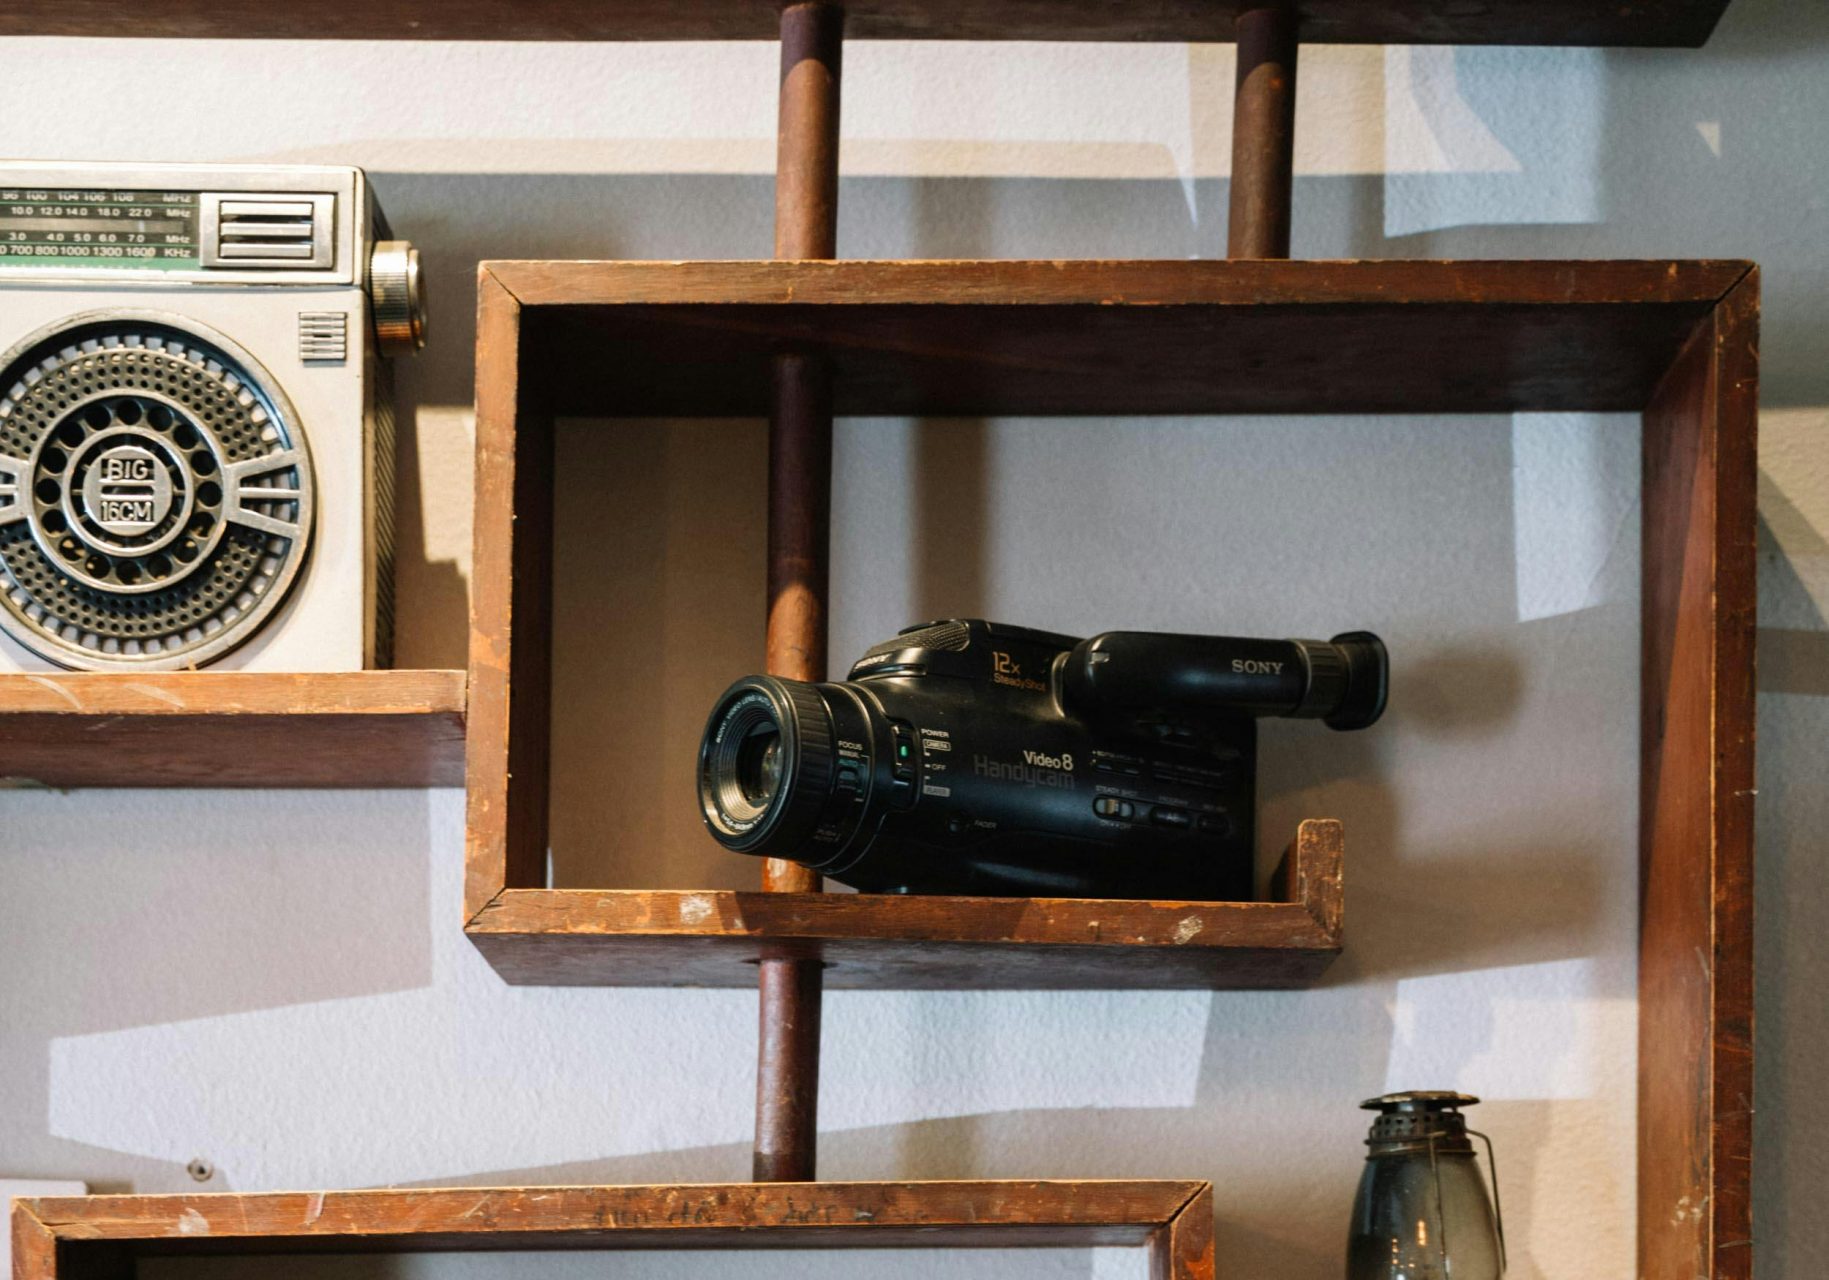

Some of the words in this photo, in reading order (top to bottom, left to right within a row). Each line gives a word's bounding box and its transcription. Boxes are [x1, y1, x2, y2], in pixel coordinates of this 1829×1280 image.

[11, 206, 34, 216] 10.0
[40, 206, 63, 216] 12.0
[66, 207, 88, 217] 14.0
[128, 208, 152, 218] 22.0
[166, 208, 191, 218] MHz
[9, 232, 27, 241] 3.0
[46, 233, 65, 242] 4.0
[73, 233, 92, 242] 5.0
[98, 234, 117, 243] 6.0
[128, 234, 145, 243] 7.0
[165, 235, 191, 244] MHz
[9, 245, 33, 256] 700
[34, 246, 59, 256] 800
[60, 246, 90, 257] 1000
[93, 246, 123, 257] 1300
[126, 247, 156, 258] 1600
[164, 248, 191, 258] KHz
[106, 458, 149, 481] BIG
[102, 501, 152, 522] 16CM
[992, 651, 1022, 675] 12x
[1231, 659, 1284, 675] SONY
[920, 728, 950, 738] POWER
[837, 740, 863, 751] FOCUS
[974, 754, 1076, 789] Handycam
